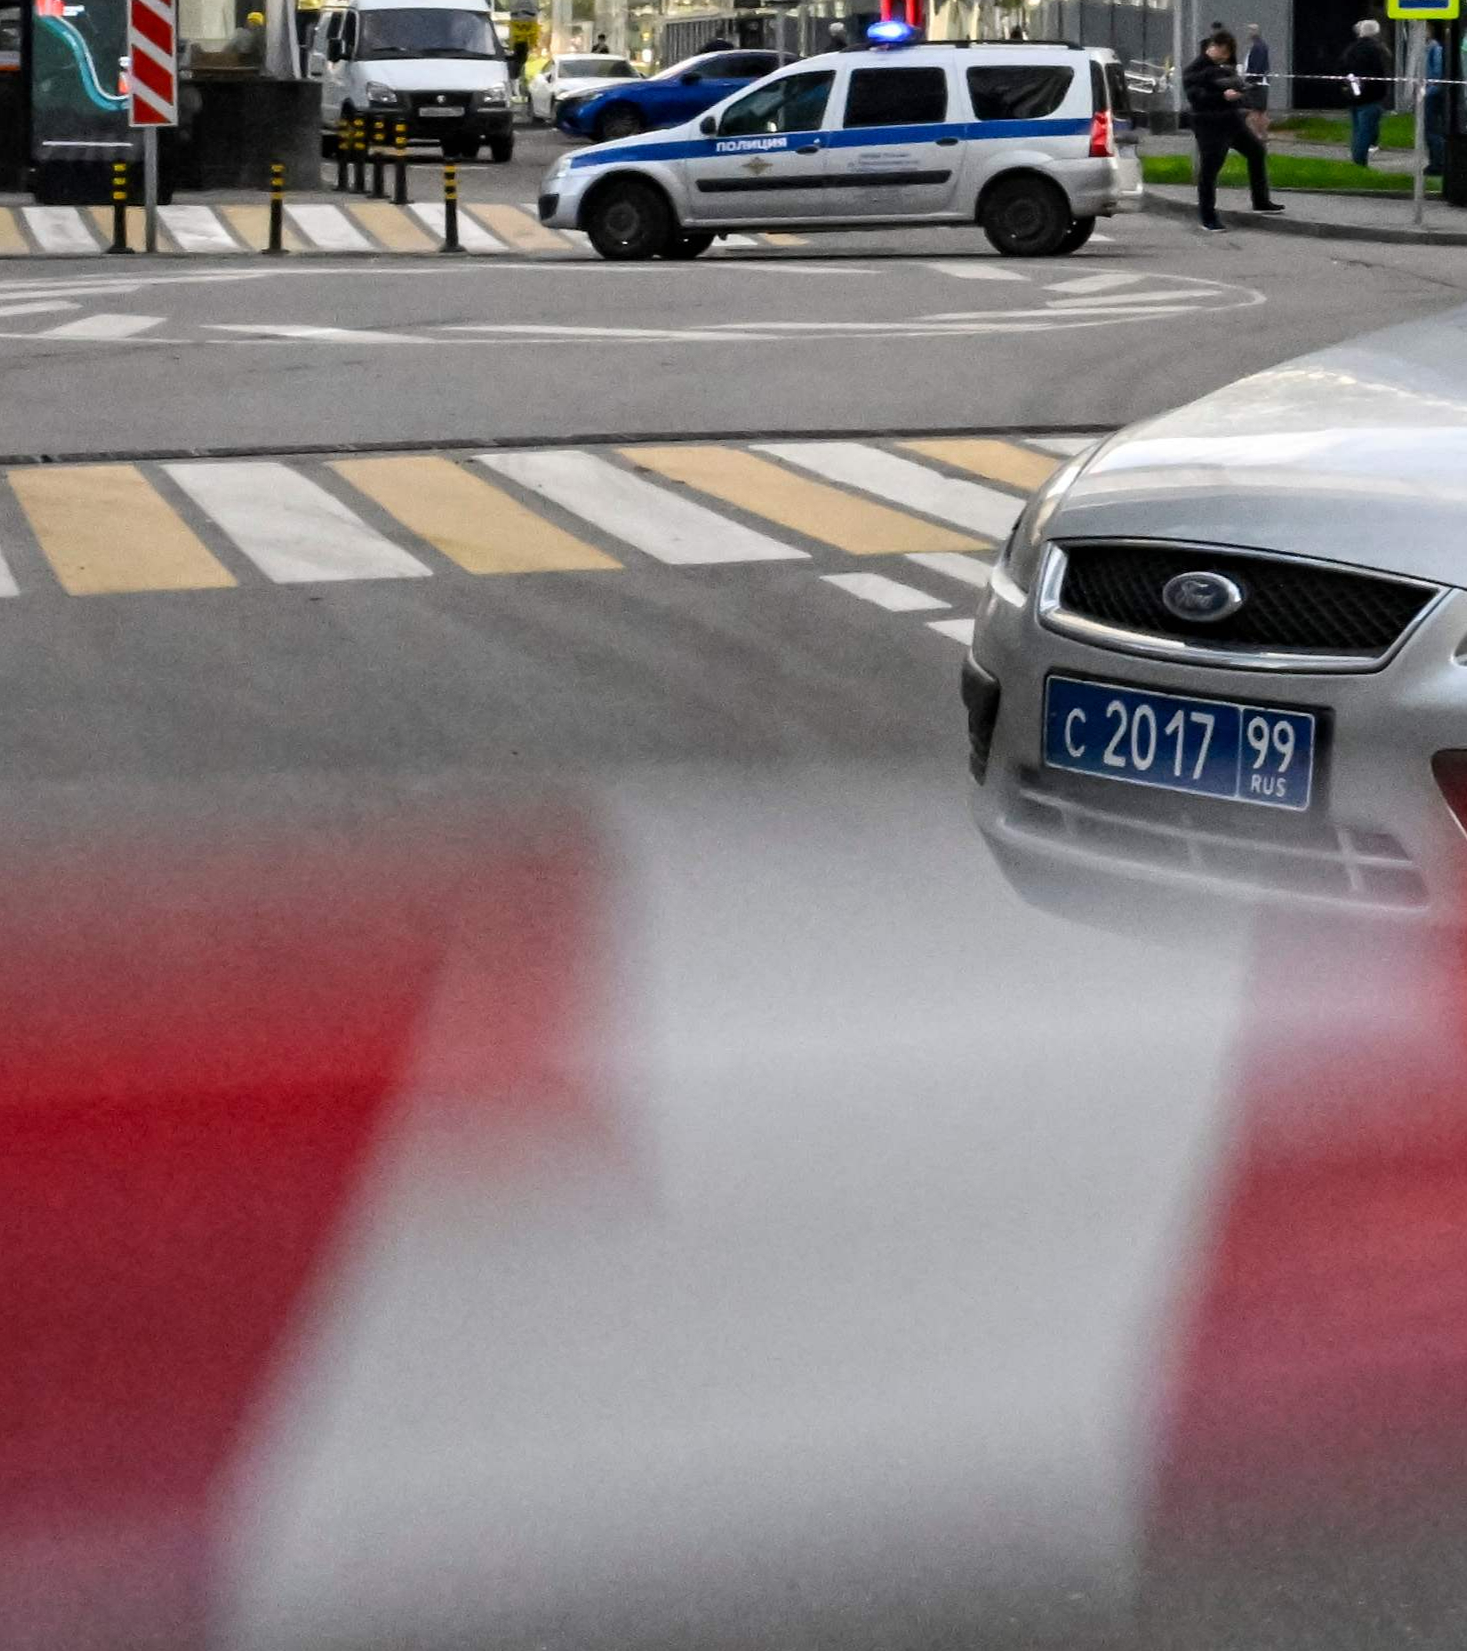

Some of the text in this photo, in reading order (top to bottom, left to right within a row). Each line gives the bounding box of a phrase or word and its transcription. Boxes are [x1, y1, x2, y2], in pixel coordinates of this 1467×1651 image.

[716, 137, 787, 153] ПОЛИЦИЯ
[1103, 700, 1215, 780] 2017
[1247, 716, 1295, 772] 99
[1250, 774, 1287, 797] RUS
